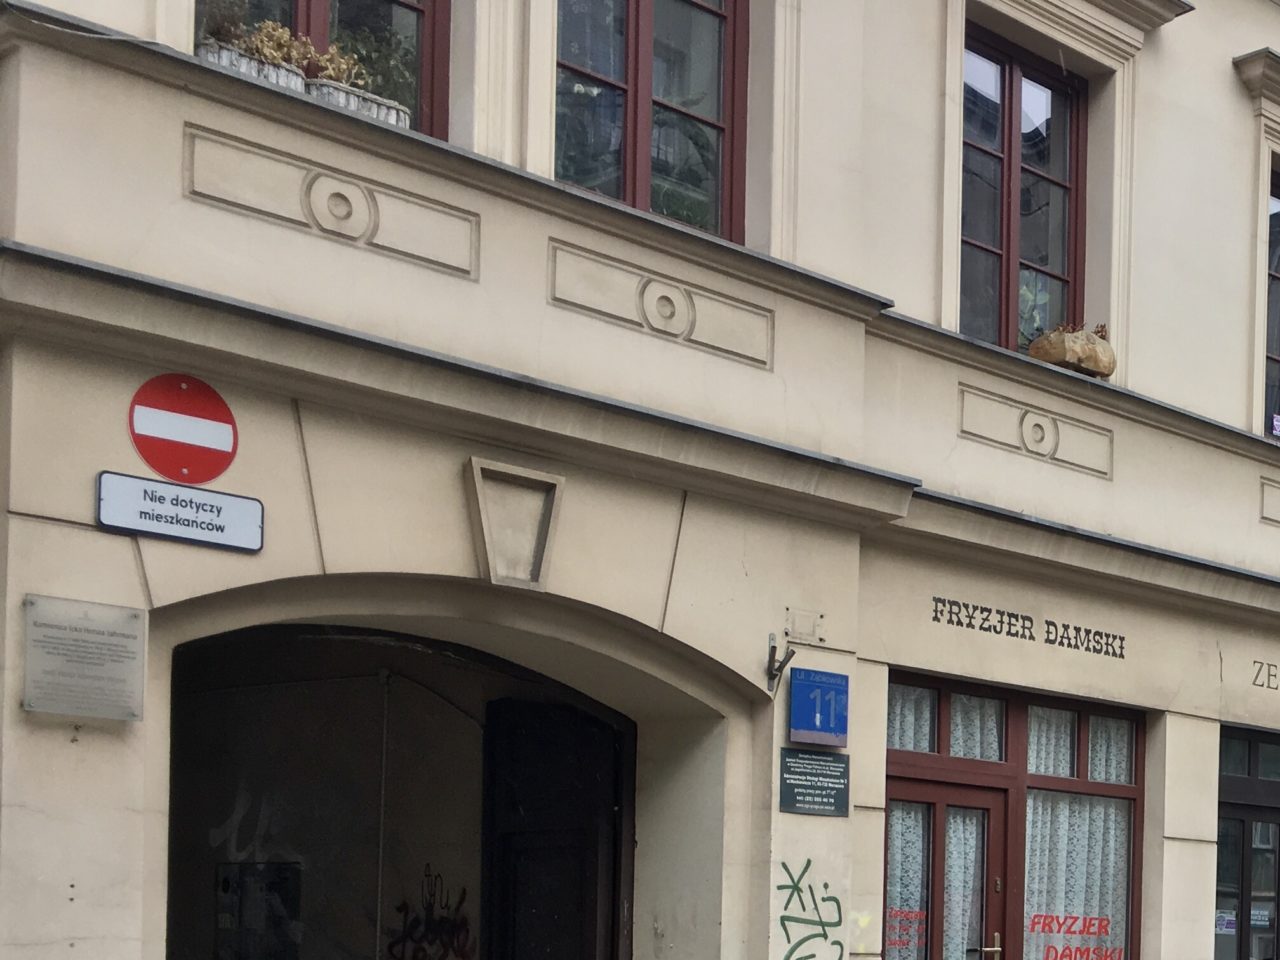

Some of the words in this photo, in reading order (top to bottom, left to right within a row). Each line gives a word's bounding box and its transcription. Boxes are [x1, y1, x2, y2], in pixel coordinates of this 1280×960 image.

[142, 488, 166, 505] Nie
[170, 493, 223, 518] dotyczy
[138, 509, 226, 535] mieszkańców
[932, 596, 1036, 642] FRYZJER
[1044, 619, 1126, 660] DAMSKI
[809, 688, 836, 728] 11
[1028, 914, 1111, 937] FRYZJER
